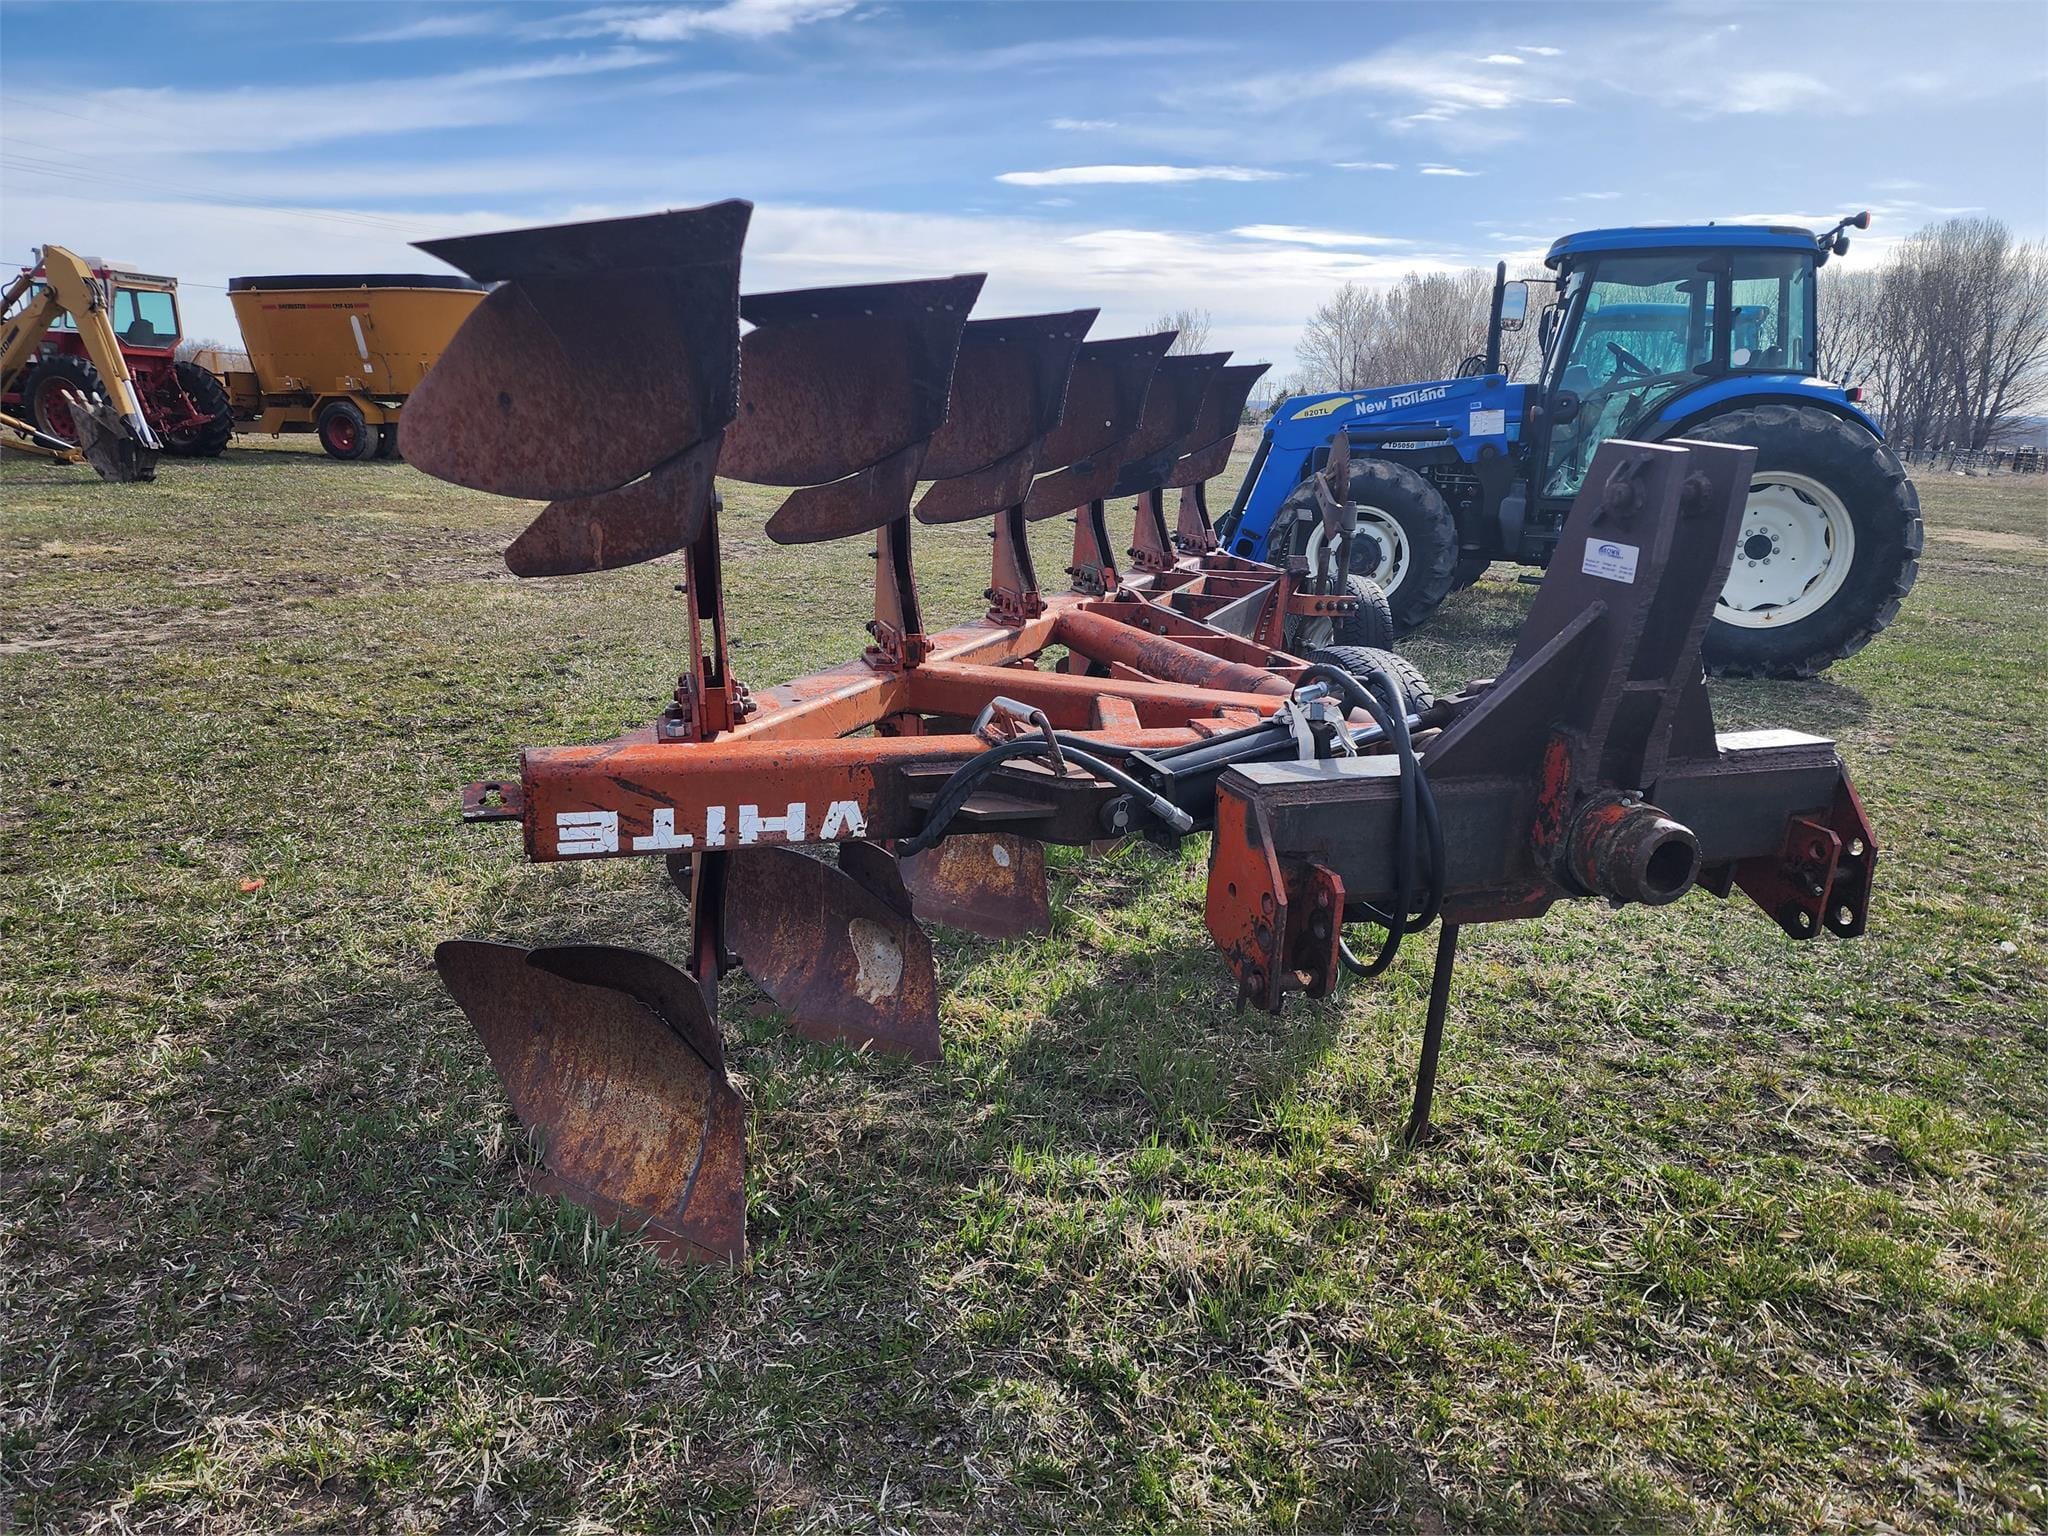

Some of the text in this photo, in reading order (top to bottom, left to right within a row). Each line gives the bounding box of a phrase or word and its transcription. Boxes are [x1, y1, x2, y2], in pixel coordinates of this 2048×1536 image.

[1355, 386, 1446, 416] New Holland
[1304, 408, 1329, 417] 820TL
[1388, 441, 1416, 449] TD5050
